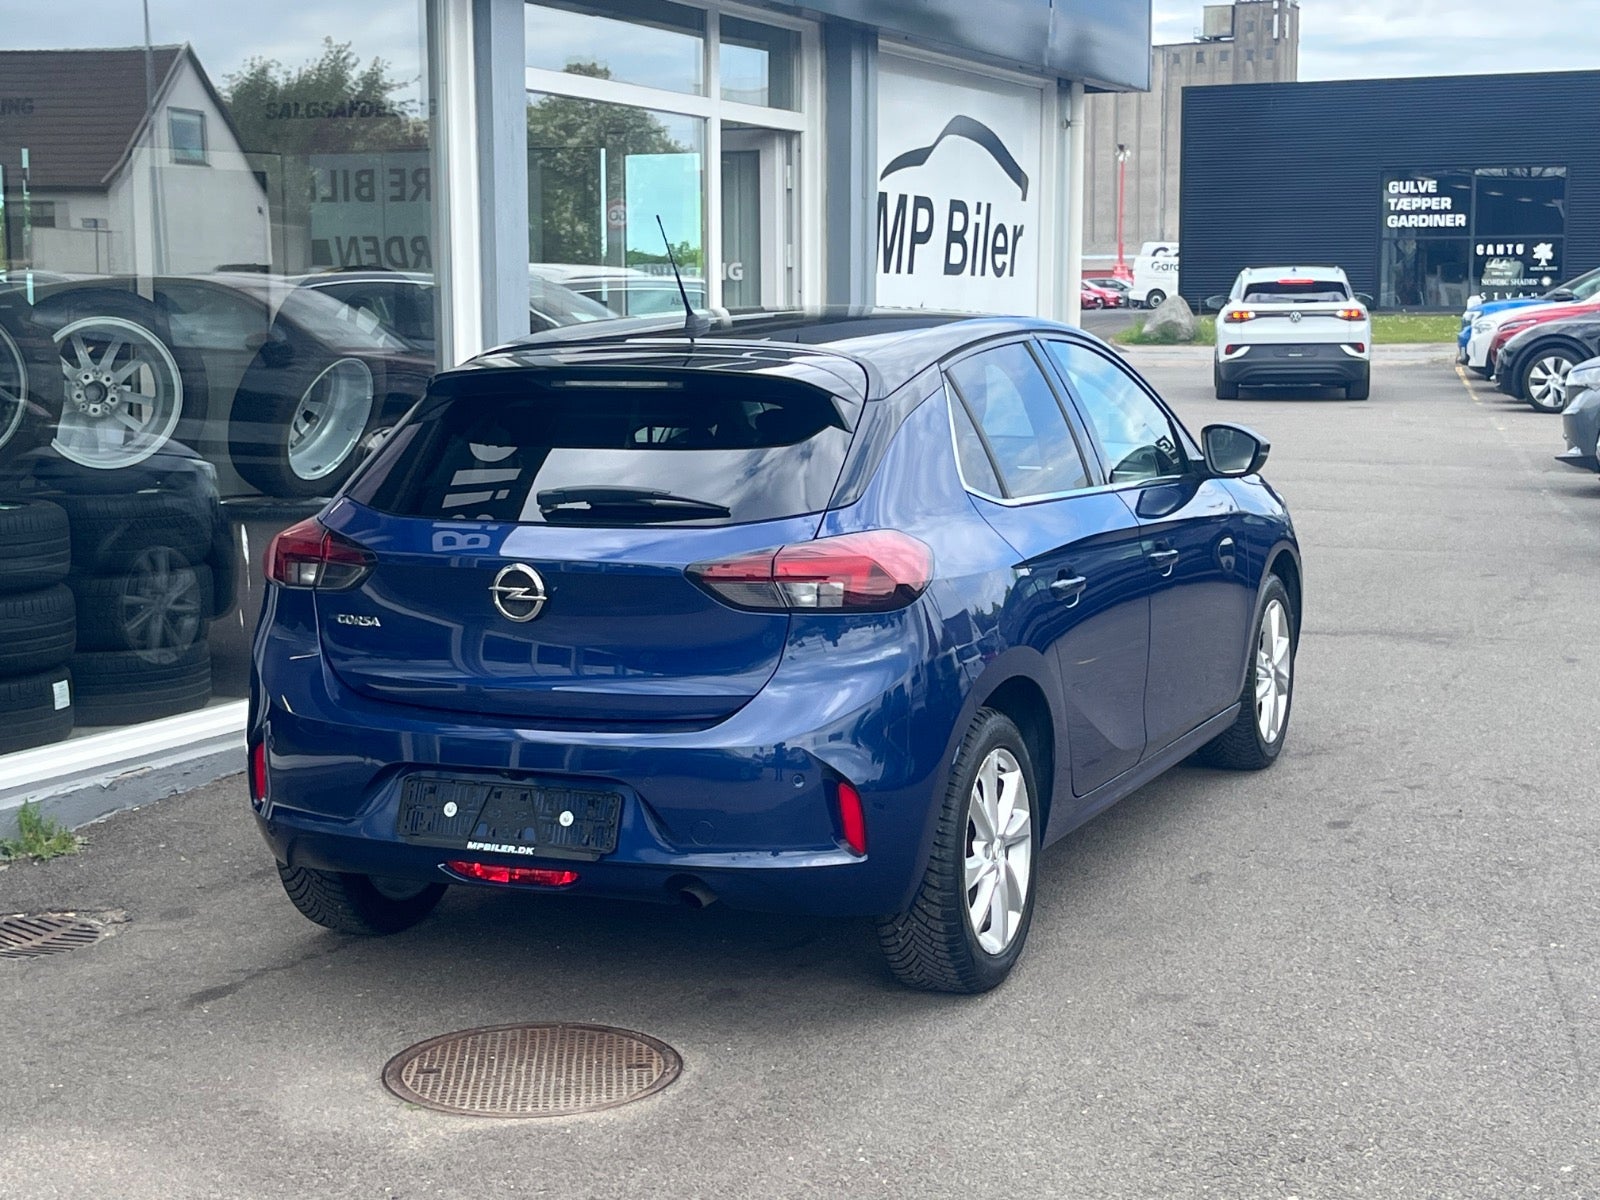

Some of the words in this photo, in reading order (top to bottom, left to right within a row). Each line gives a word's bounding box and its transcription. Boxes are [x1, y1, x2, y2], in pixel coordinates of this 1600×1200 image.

[1388, 180, 1437, 194] GULVE
[1388, 197, 1452, 211] TÆPPER
[1387, 214, 1466, 228] GARDINER
[876, 191, 934, 275] MP
[943, 199, 1025, 278] Biler
[337, 614, 382, 627] CORSA
[466, 841, 535, 856] MPBILER.DK
